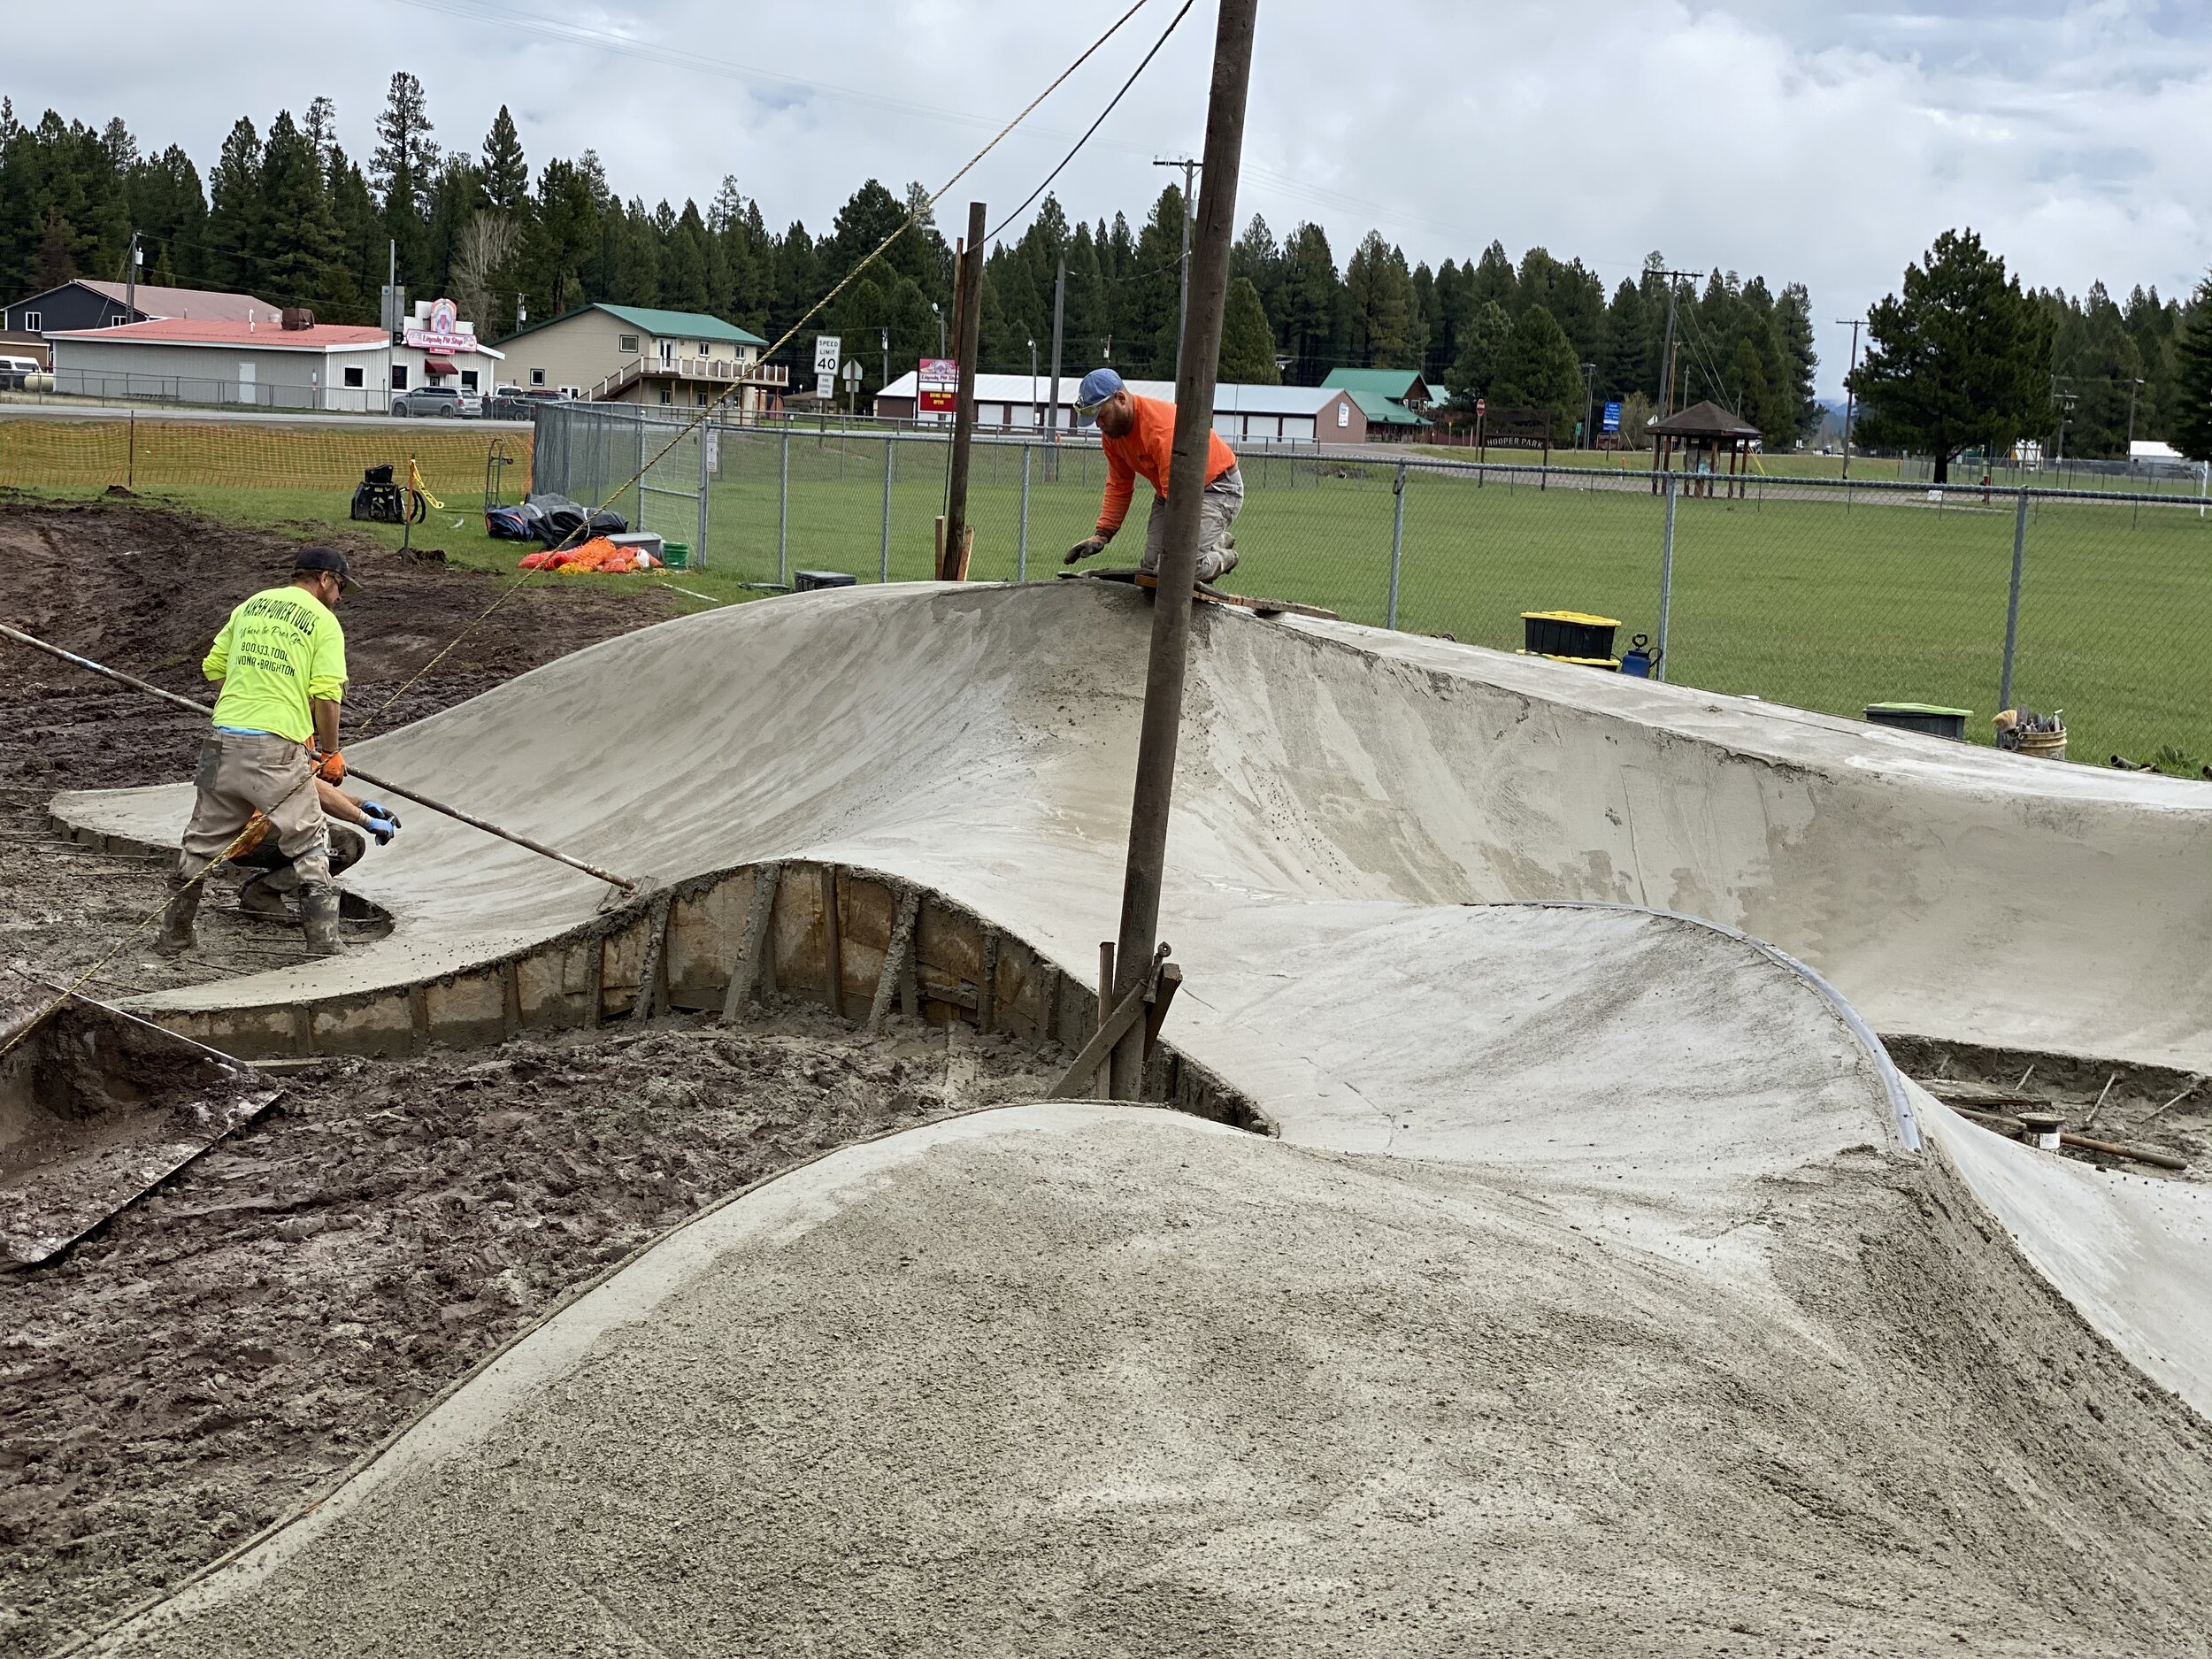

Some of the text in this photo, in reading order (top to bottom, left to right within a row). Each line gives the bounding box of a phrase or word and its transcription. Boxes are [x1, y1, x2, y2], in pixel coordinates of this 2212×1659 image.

[451, 337, 463, 346] Stop
[817, 357, 836, 370] 40
[1486, 437, 1543, 449] HOOPER PARK
[264, 600, 297, 622] POWER
[290, 606, 319, 636] TOOLS
[271, 626, 288, 638] Pros
[260, 659, 296, 677] BRIGHTON
